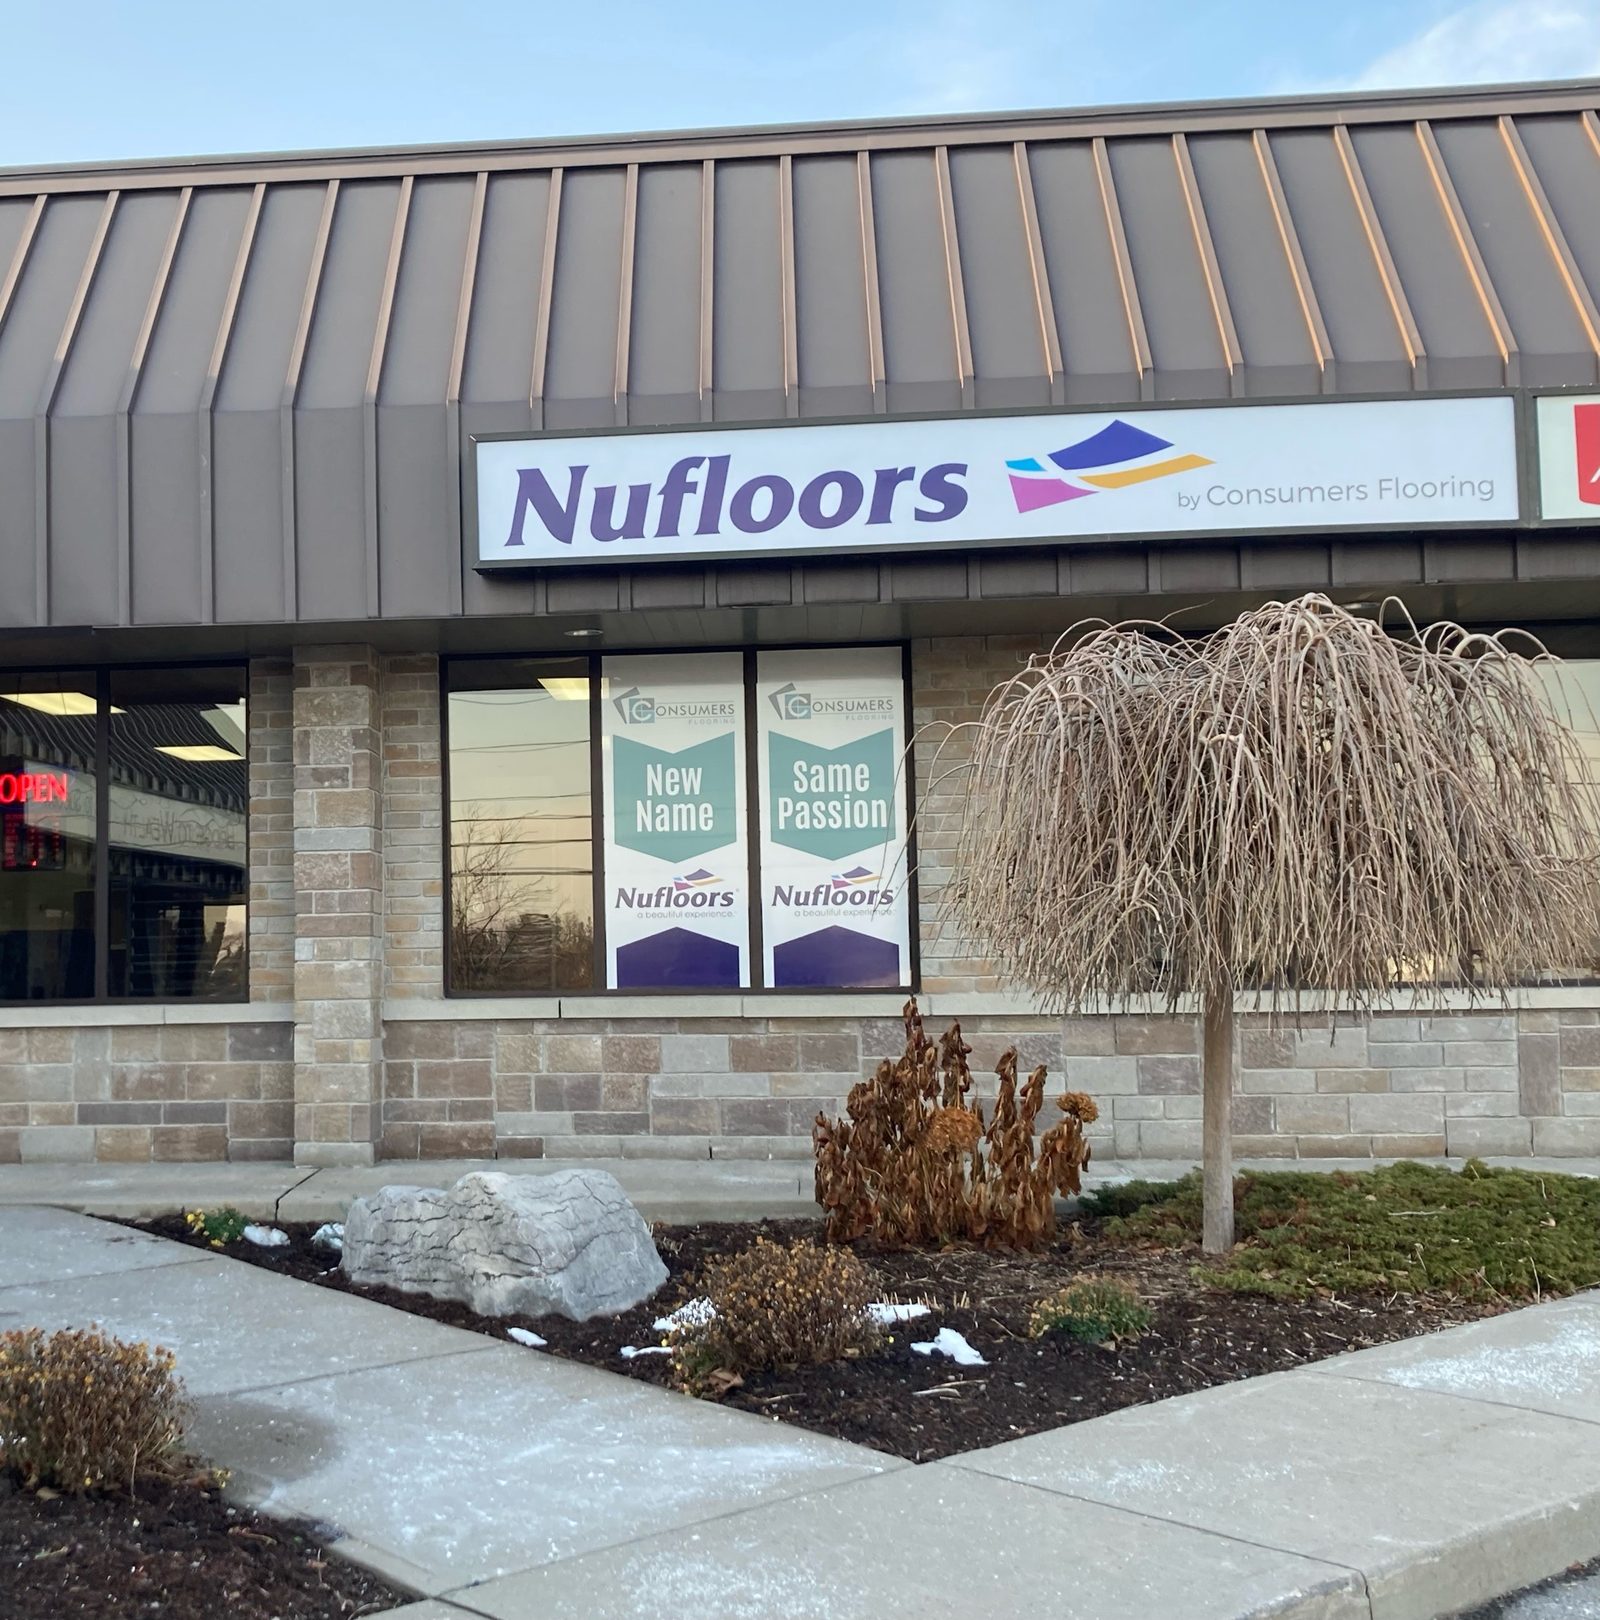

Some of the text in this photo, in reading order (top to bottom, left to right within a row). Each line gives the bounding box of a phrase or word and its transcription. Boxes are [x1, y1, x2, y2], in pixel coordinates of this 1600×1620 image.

[504, 453, 969, 547] Nufloors
[1177, 475, 1495, 511] by Consumers Flooring
[0, 772, 68, 803] OPEN
[646, 764, 703, 796] New
[793, 760, 870, 793] Same
[636, 799, 714, 832] Name
[778, 793, 887, 830] Passion
[615, 886, 735, 909] Nufloors
[771, 884, 894, 907] Nufloors
[637, 911, 644, 919] a
[645, 909, 683, 919] beautiful
[794, 909, 801, 917] a
[802, 907, 841, 917] beautiful
